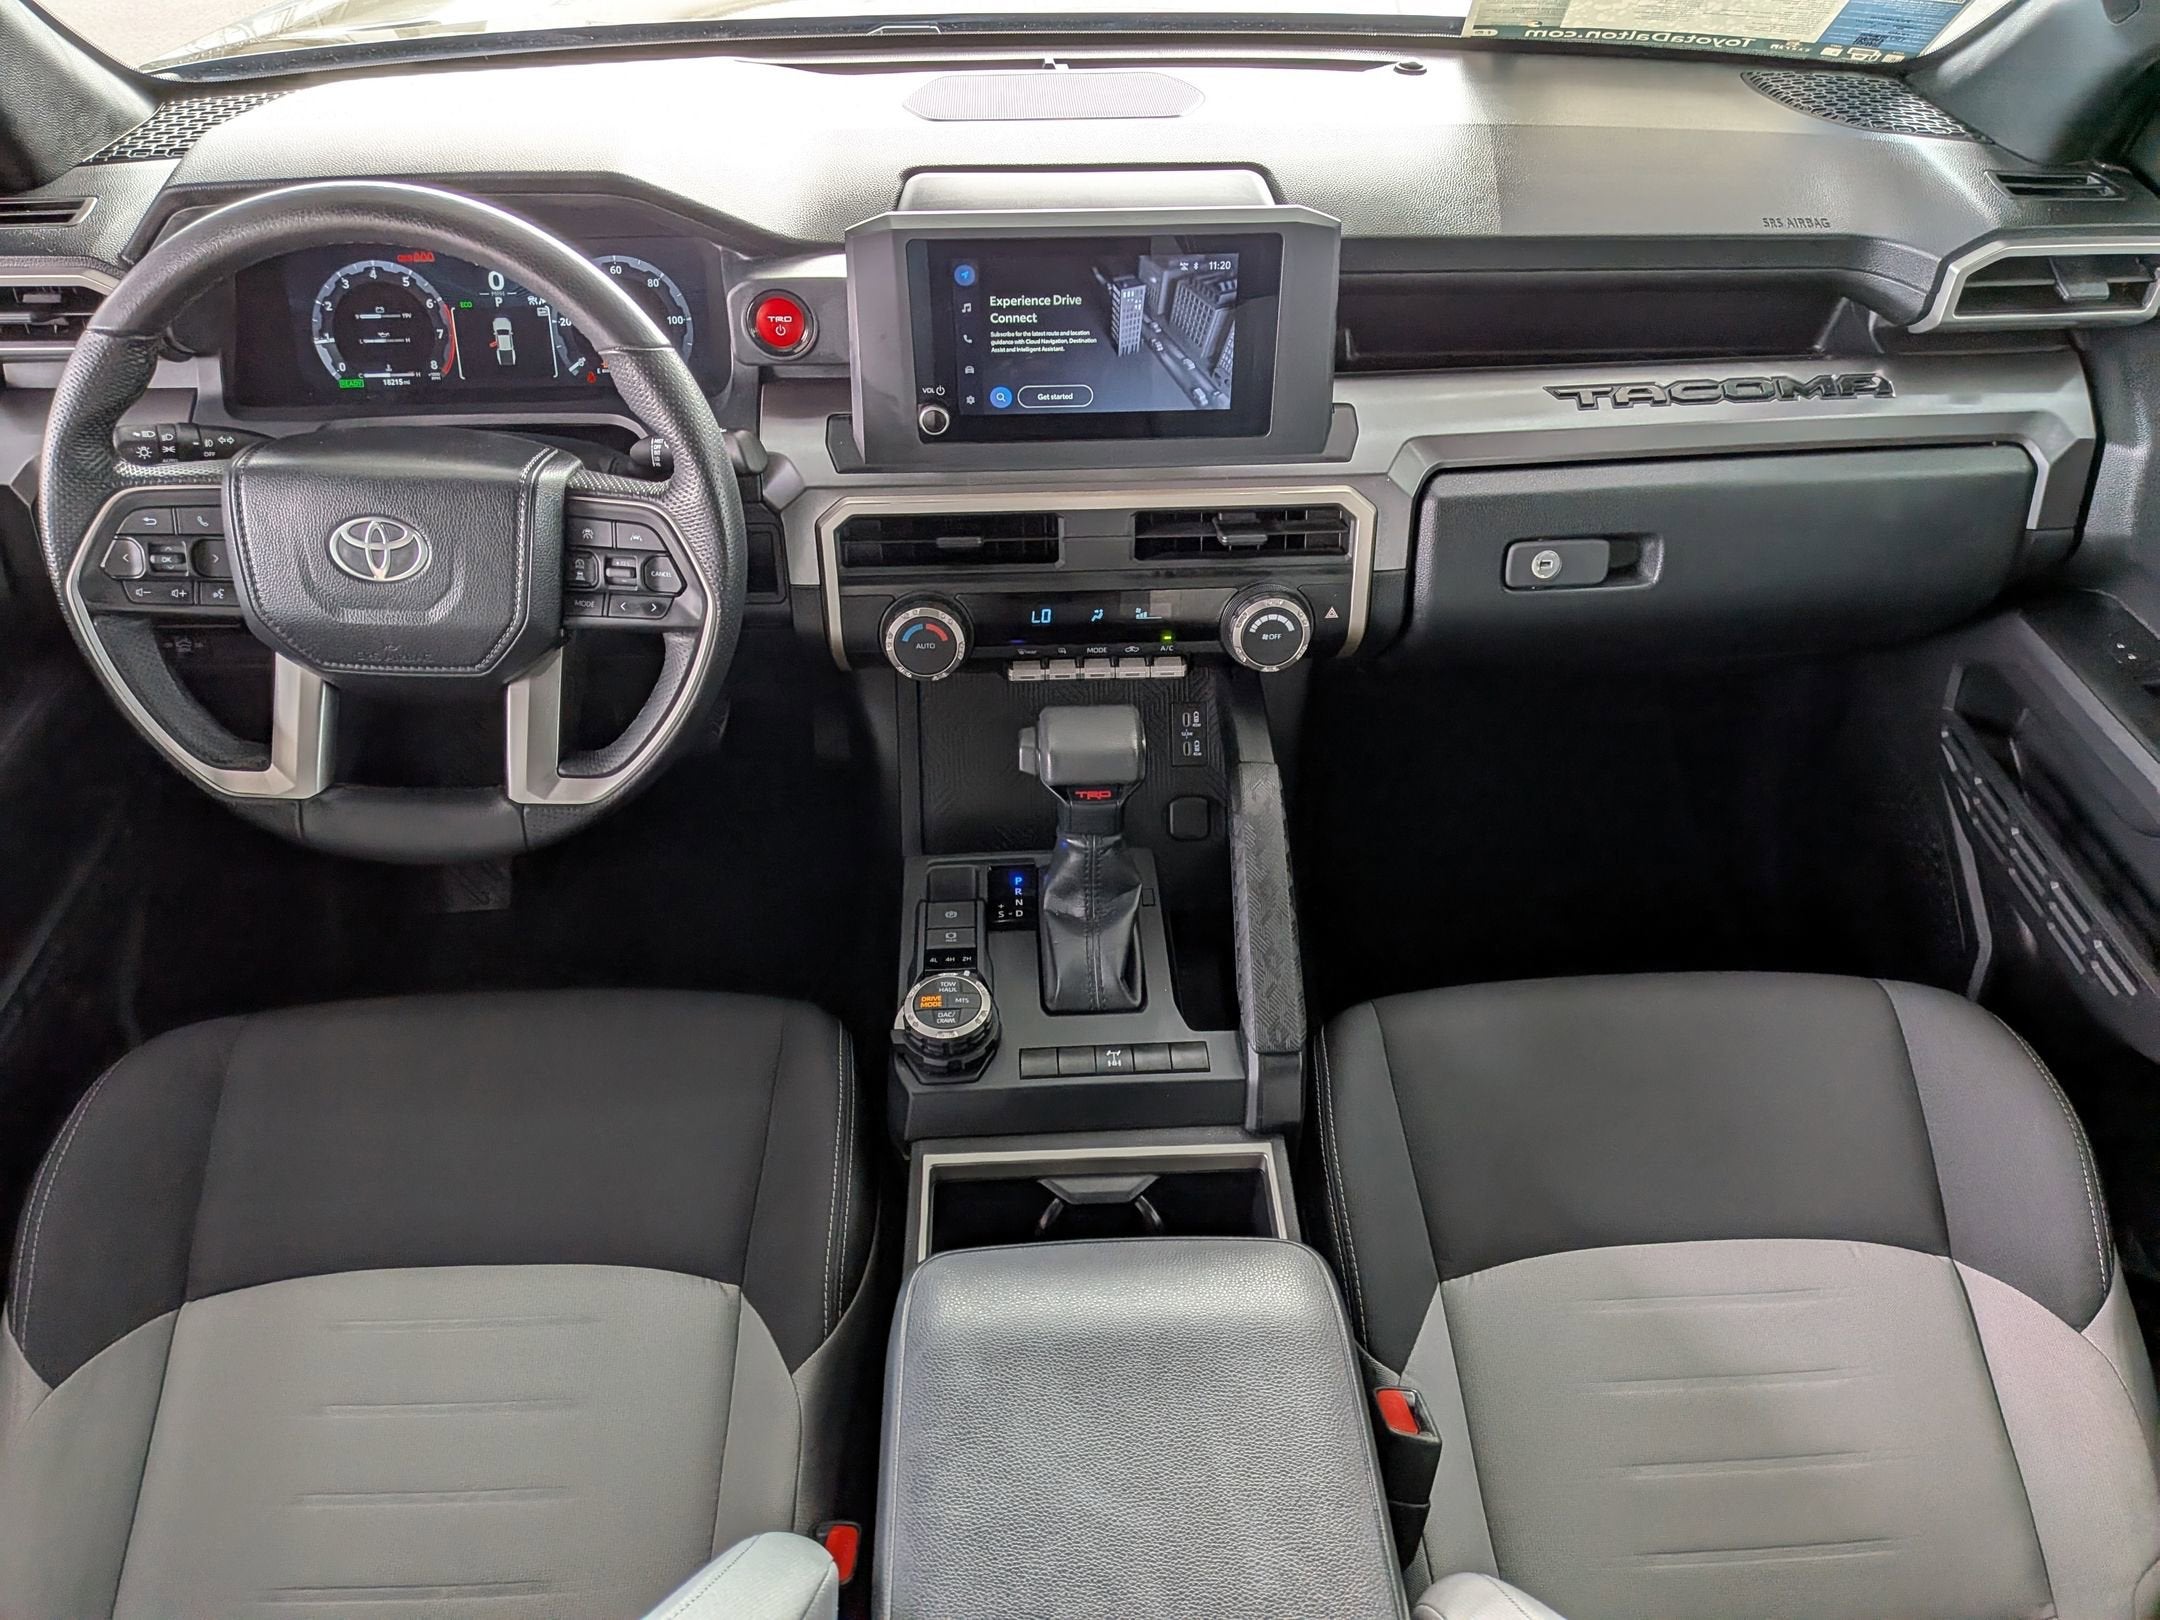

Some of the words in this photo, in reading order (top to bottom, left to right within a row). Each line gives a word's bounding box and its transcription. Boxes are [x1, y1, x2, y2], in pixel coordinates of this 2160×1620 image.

[1762, 217, 1784, 228] SRS
[1787, 217, 1831, 229] AIRBAG
[1209, 260, 1231, 270] 11:20
[369, 269, 378, 280] 4
[610, 266, 622, 275] 60
[341, 279, 350, 289] 3
[402, 276, 410, 287] 5
[488, 271, 505, 290] 0
[647, 278, 660, 288] 80
[324, 301, 333, 311] 2
[425, 299, 434, 309] 6
[495, 297, 503, 307] P
[989, 295, 1051, 309] Experience
[1053, 294, 1082, 306] Drive
[560, 317, 572, 326] 20
[667, 316, 683, 325] 100
[990, 313, 1038, 324] Connect
[436, 329, 444, 339] 7
[991, 339, 1014, 347] guidance
[1016, 345, 1041, 354] Intelligent
[339, 362, 347, 372] 0
[430, 360, 438, 370] 8
[1544, 371, 1896, 411] TACOMA
[1037, 393, 1050, 401] Get
[1050, 392, 1074, 400] started
[650, 570, 672, 578] CANCEL
[1031, 608, 1052, 624] LO
[1075, 790, 1112, 799] TRD
[1015, 876, 1023, 885] P
[1014, 887, 1023, 896] R
[1015, 898, 1024, 906] N
[998, 910, 1005, 918] S
